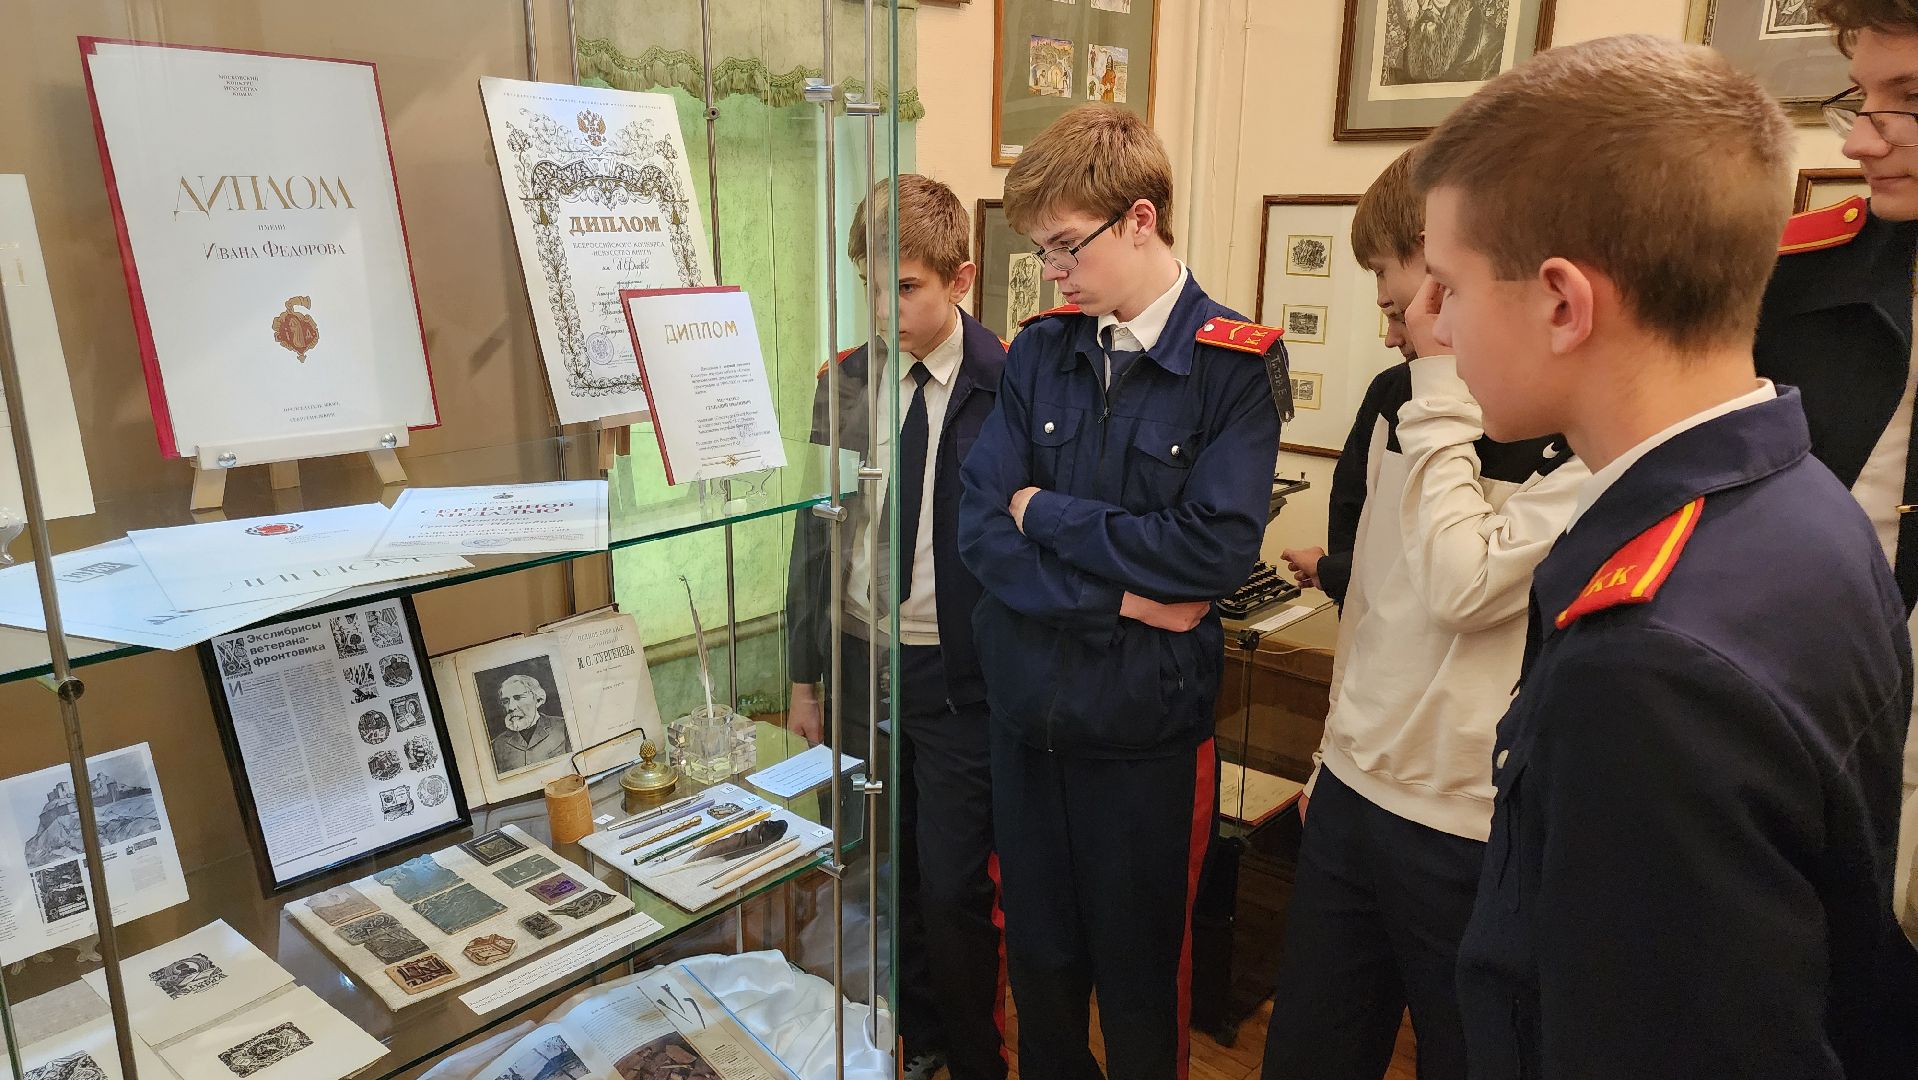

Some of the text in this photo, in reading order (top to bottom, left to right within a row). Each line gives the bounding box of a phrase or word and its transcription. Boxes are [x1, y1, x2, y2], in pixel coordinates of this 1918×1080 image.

[173, 175, 357, 221] ДИПЛОМ
[569, 216, 662, 236] ДИПЛОМ
[664, 320, 739, 344] ДИПЛОМ
[246, 621, 322, 643] Экслибрисы
[249, 636, 310, 656] ветерана-
[253, 642, 326, 668] фронтовика
